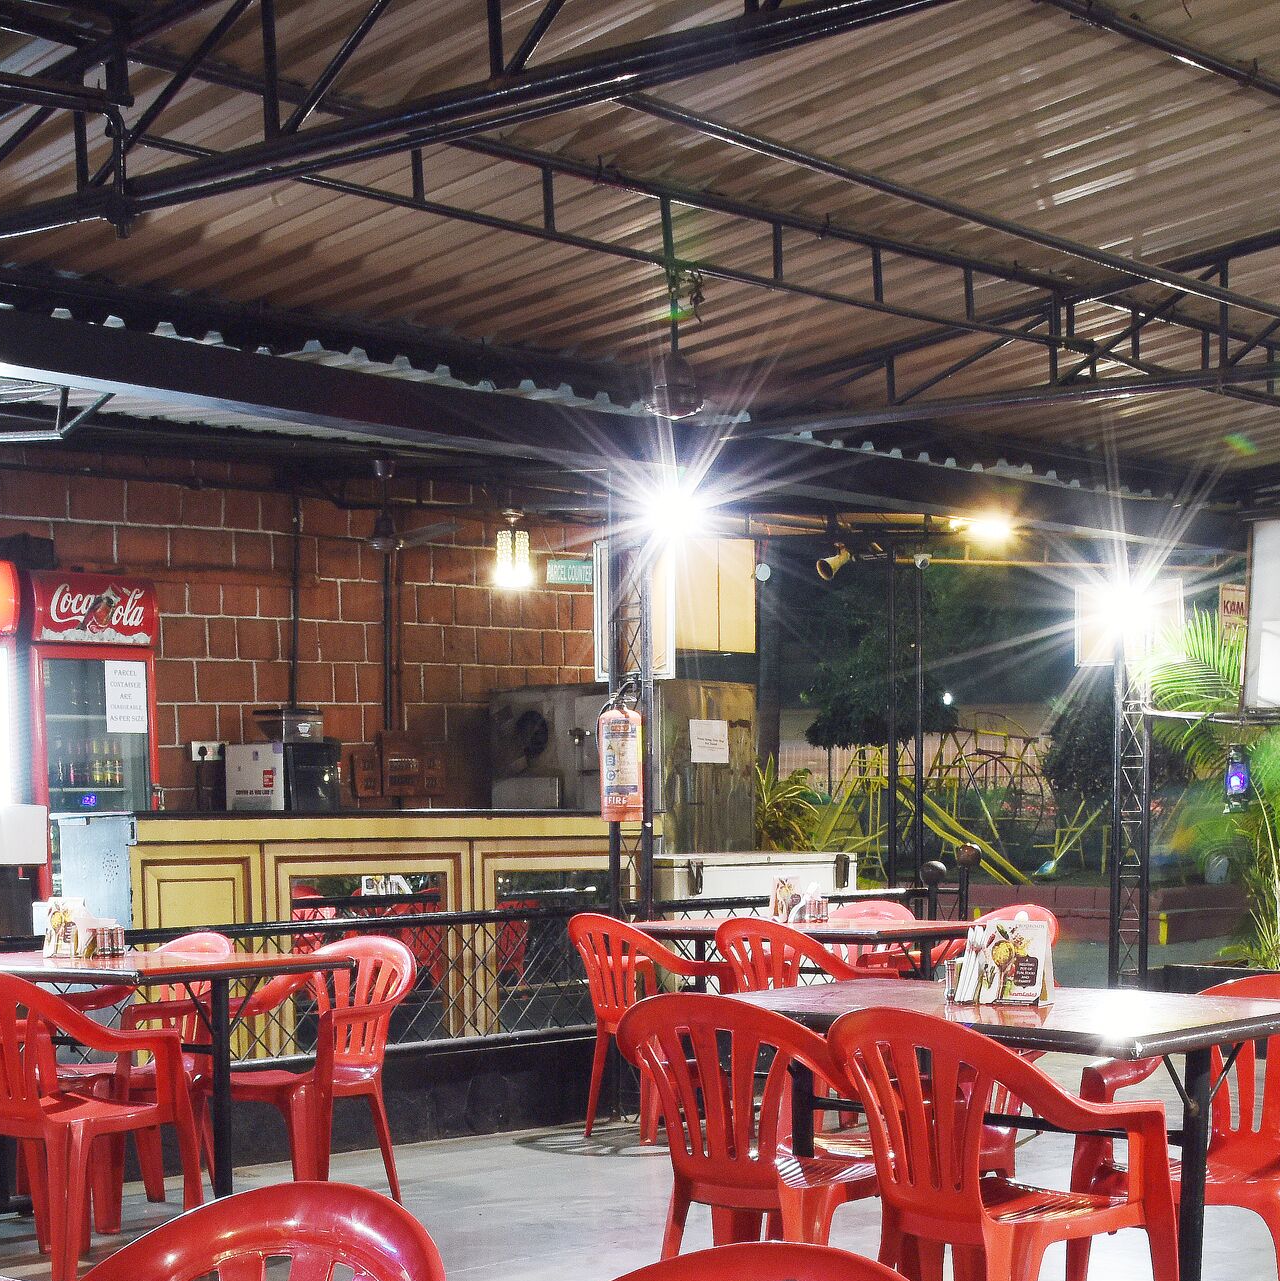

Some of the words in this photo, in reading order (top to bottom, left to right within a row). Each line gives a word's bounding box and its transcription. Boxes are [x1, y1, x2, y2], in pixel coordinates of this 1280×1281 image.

[50, 583, 145, 627] Cocaola
[113, 669, 137, 677] PARCEL
[608, 796, 628, 805] FIRE
